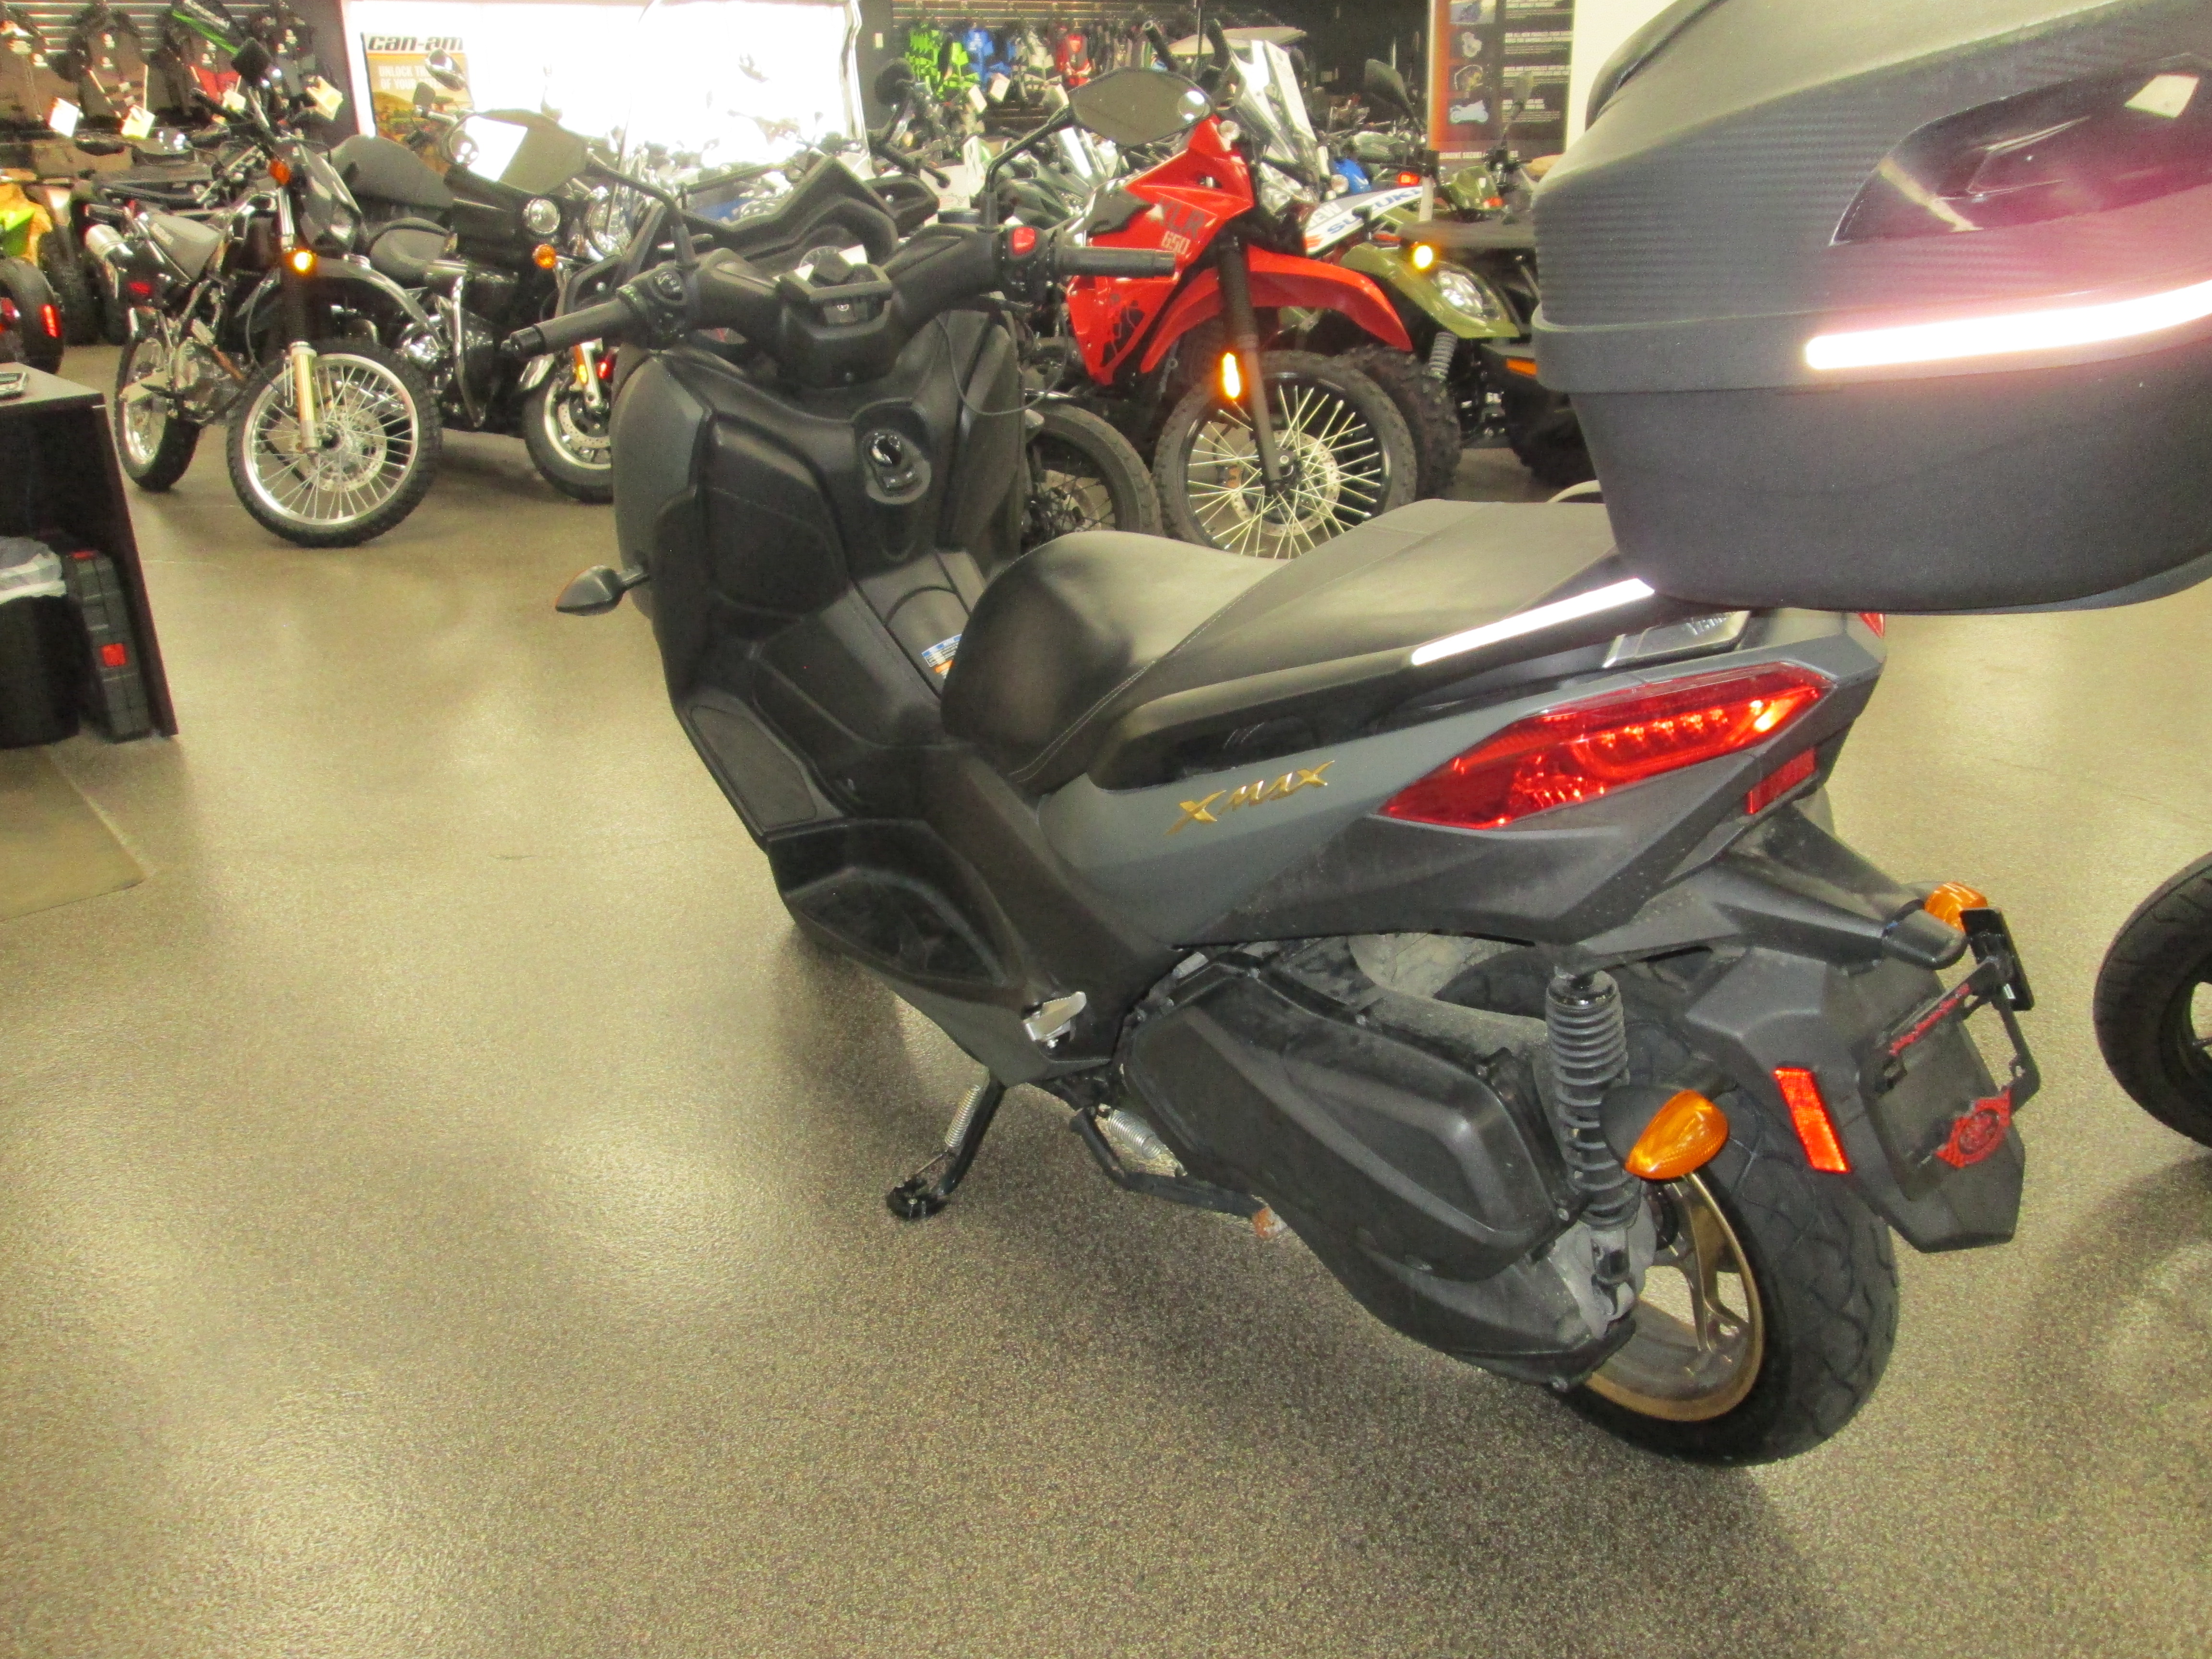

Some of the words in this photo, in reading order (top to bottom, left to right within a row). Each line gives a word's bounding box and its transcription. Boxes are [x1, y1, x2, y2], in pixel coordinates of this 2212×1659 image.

[368, 36, 462, 50] can-am
[1327, 188, 1422, 234] SUUKI
[1161, 230, 1191, 255] 650
